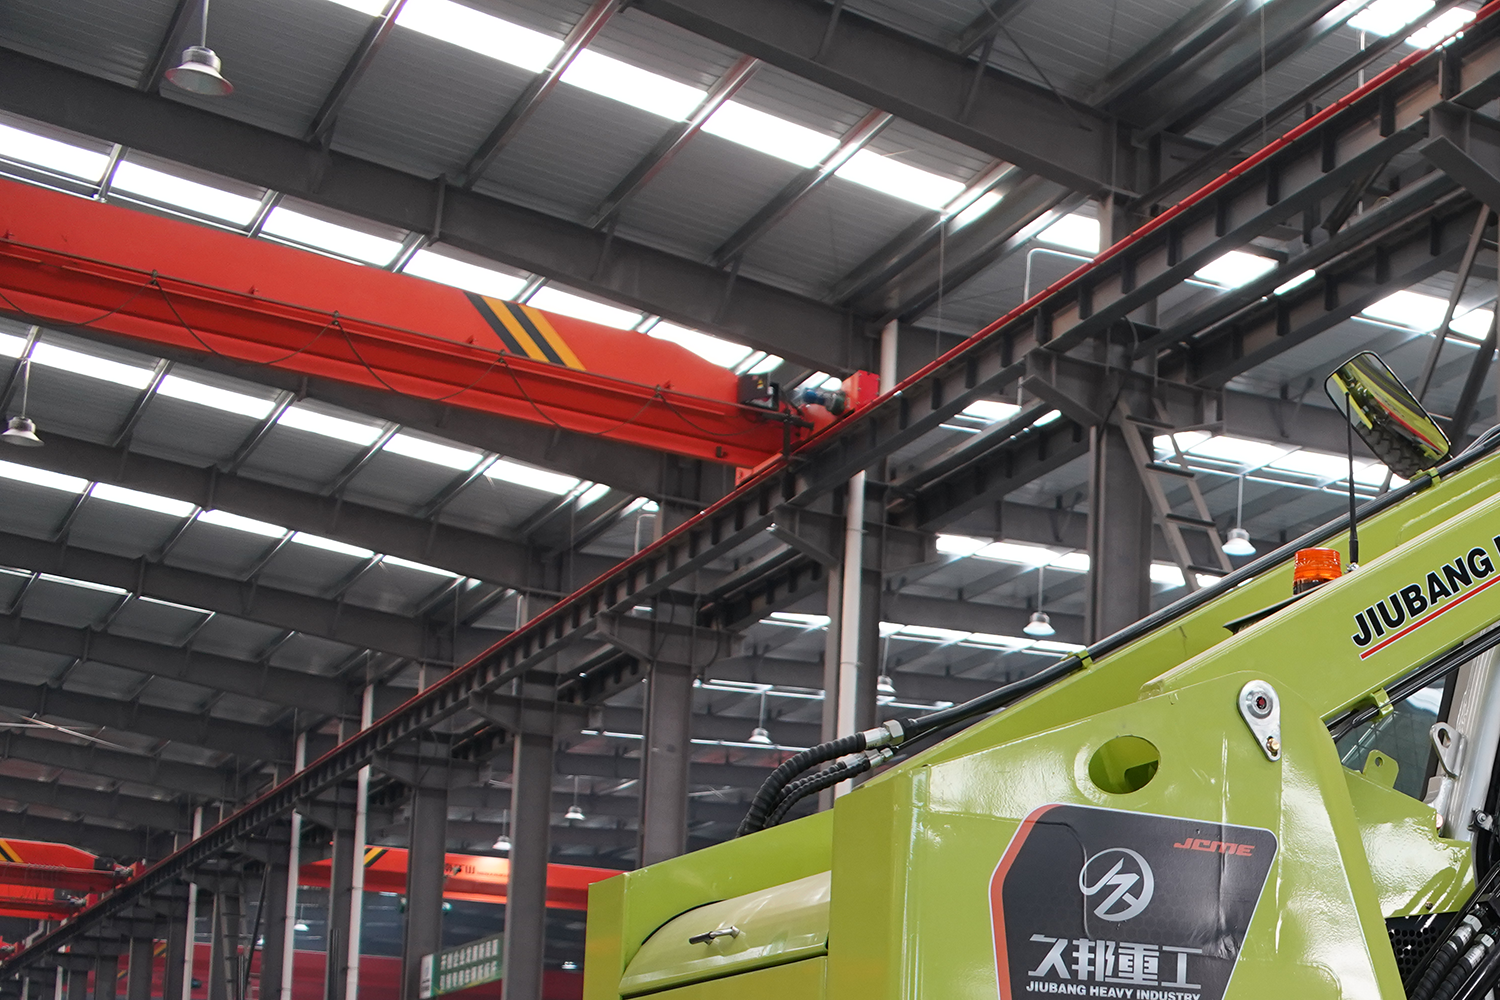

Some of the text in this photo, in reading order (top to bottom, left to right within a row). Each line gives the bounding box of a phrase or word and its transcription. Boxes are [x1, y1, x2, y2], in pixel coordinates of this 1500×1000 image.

[1351, 547, 1496, 648] JIUBANG
[1173, 837, 1256, 857] JCME
[1027, 933, 1203, 989] 久邦重工
[1025, 980, 1087, 996] JIUBANG
[1089, 986, 1134, 1000] HEAVY
